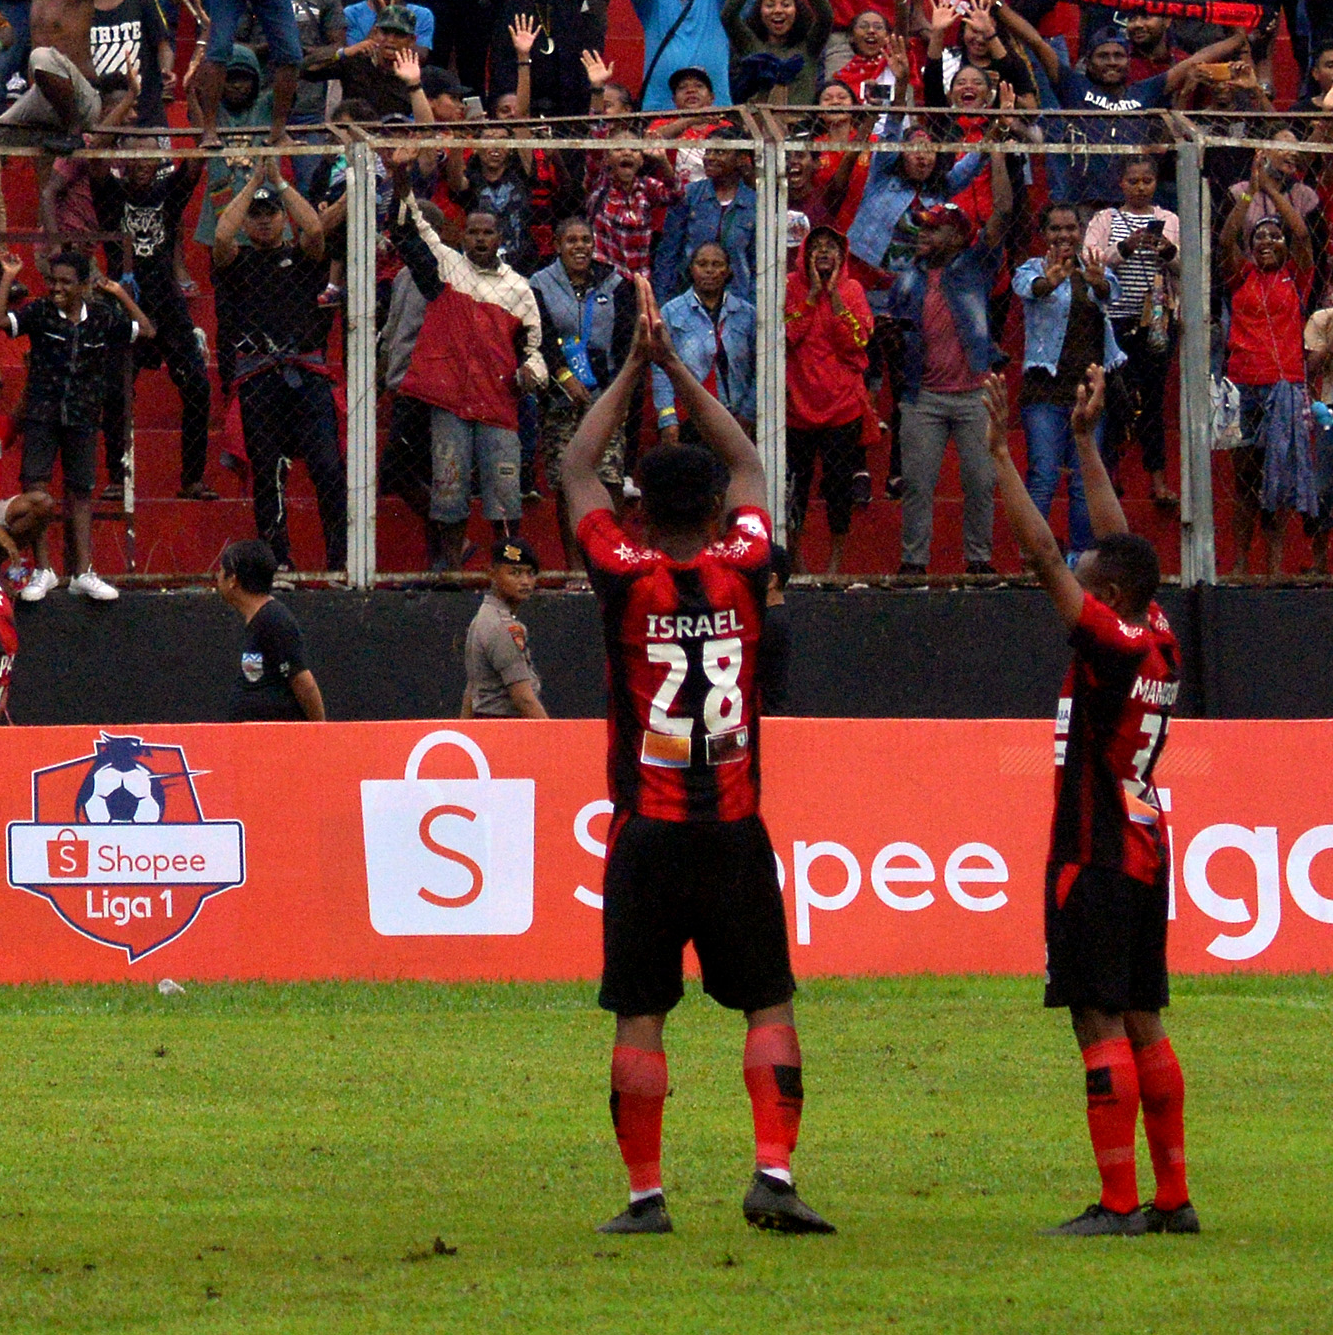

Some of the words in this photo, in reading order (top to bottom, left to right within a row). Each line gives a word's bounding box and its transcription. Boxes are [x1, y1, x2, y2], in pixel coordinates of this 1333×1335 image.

[646, 608, 745, 639] ISRAEL
[646, 637, 744, 738] 28
[97, 844, 206, 880] Shopee
[86, 889, 152, 926] Liga
[159, 889, 173, 918] 1
